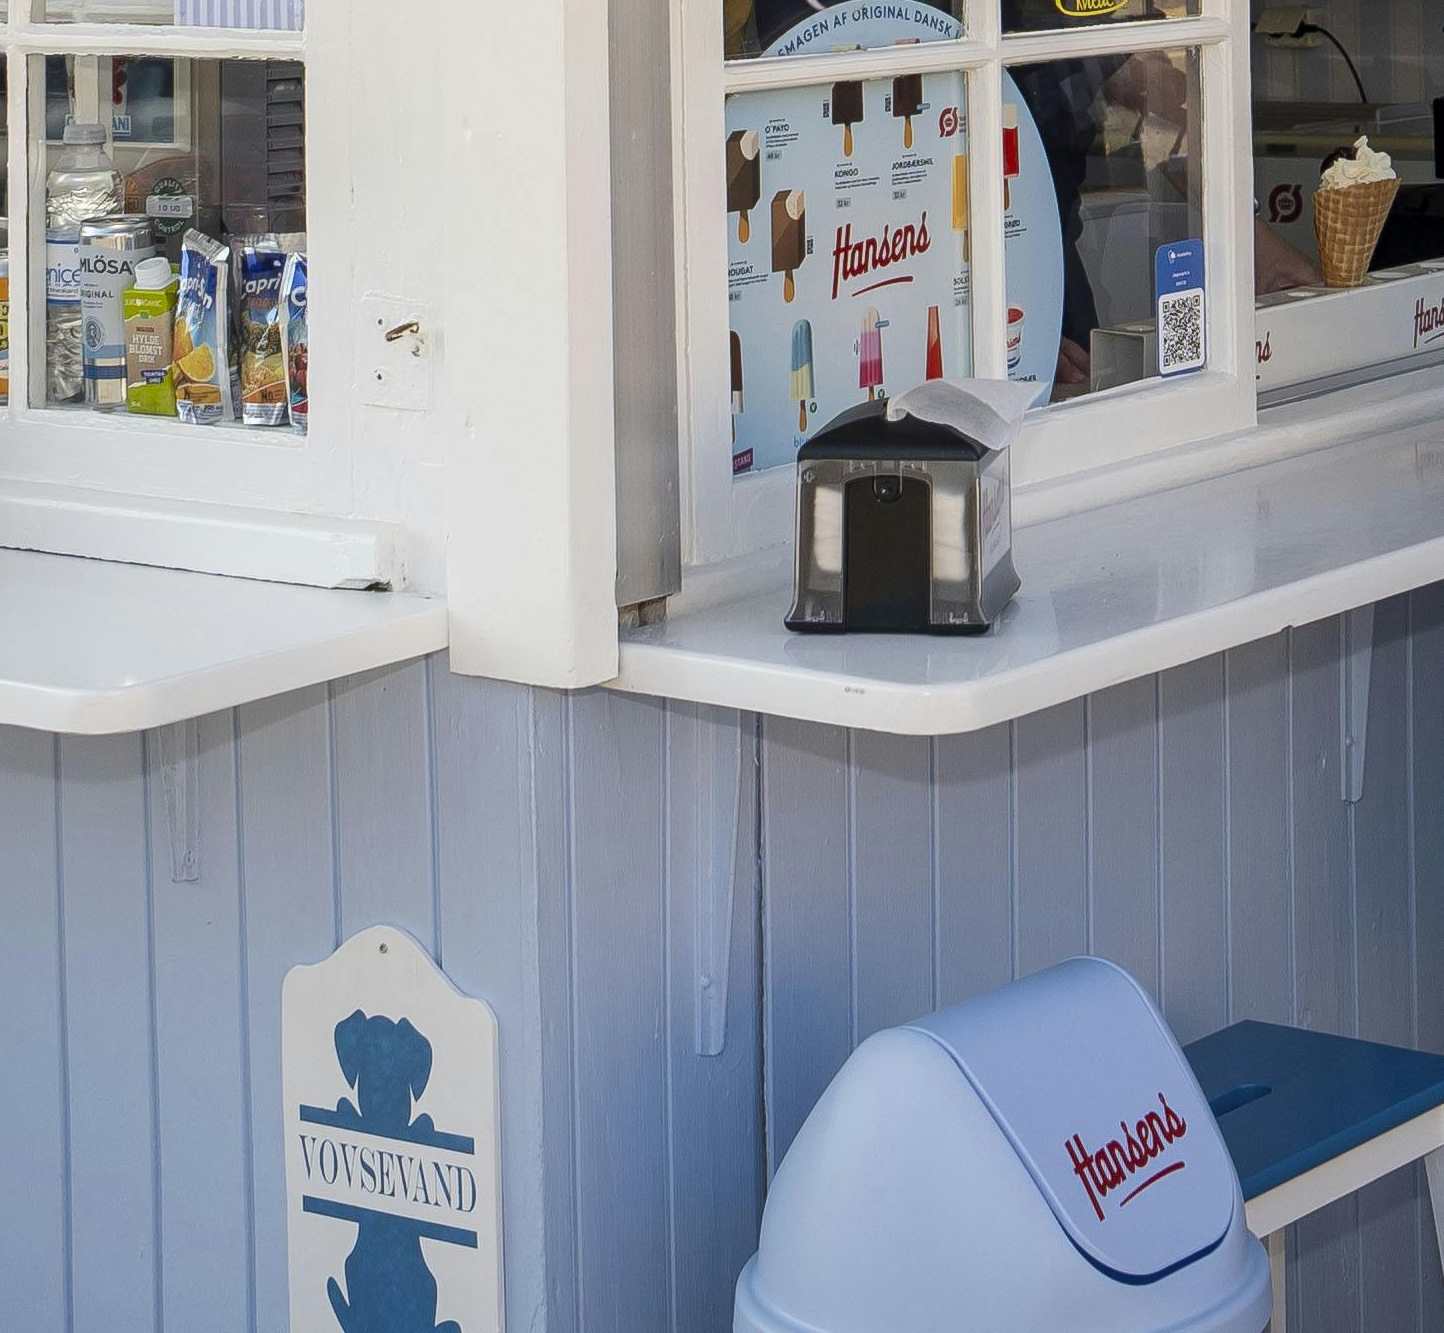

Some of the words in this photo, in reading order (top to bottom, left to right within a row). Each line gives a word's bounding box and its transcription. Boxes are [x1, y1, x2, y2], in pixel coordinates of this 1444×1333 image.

[833, 12, 847, 28] AF
[852, 5, 910, 21] ORIGINAL
[915, 10, 952, 35] DANSK
[832, 212, 931, 299] Hansens
[298, 1134, 476, 1213] VOVSEVAND
[1065, 1092, 1186, 1222] Hansens
